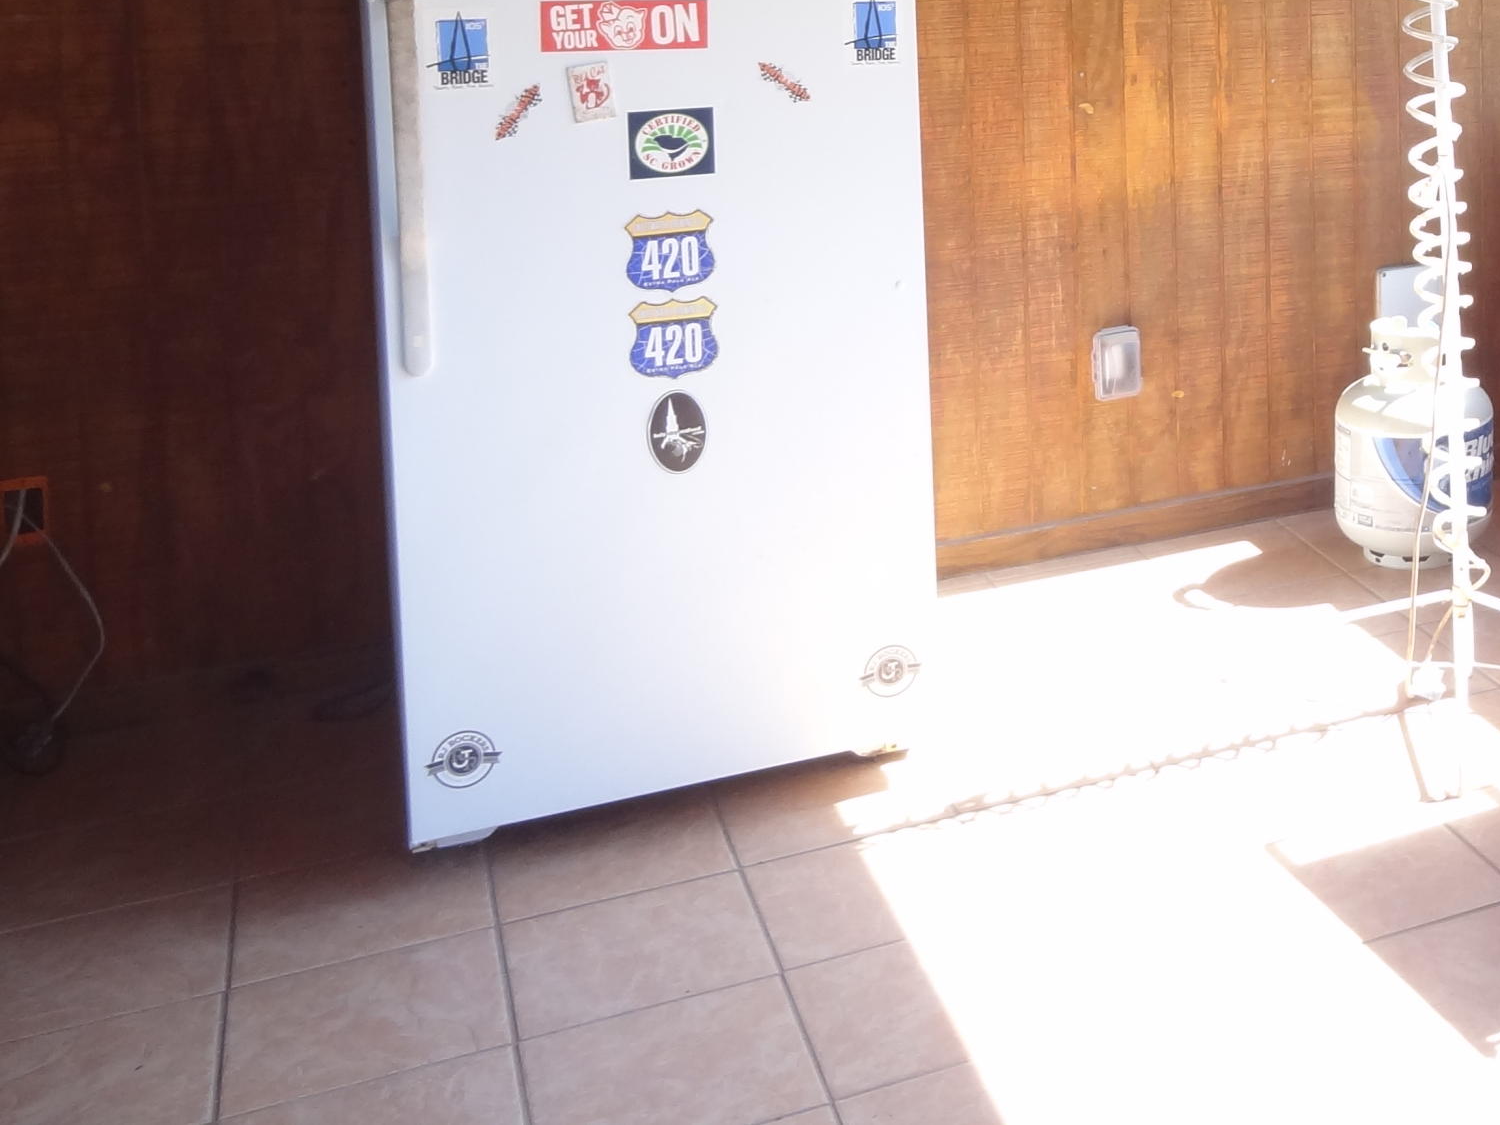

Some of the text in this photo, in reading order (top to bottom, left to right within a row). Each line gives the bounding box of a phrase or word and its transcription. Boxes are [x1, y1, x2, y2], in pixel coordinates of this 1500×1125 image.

[550, 3, 593, 31] GET
[651, 3, 700, 45] ON
[552, 30, 598, 49] YOUR
[856, 47, 897, 62] BRIDGE
[441, 69, 489, 86] BRIDGE
[642, 115, 701, 135] CERTIFIED
[661, 151, 701, 170] GROWN
[641, 236, 700, 280] 420
[644, 322, 703, 367] 420
